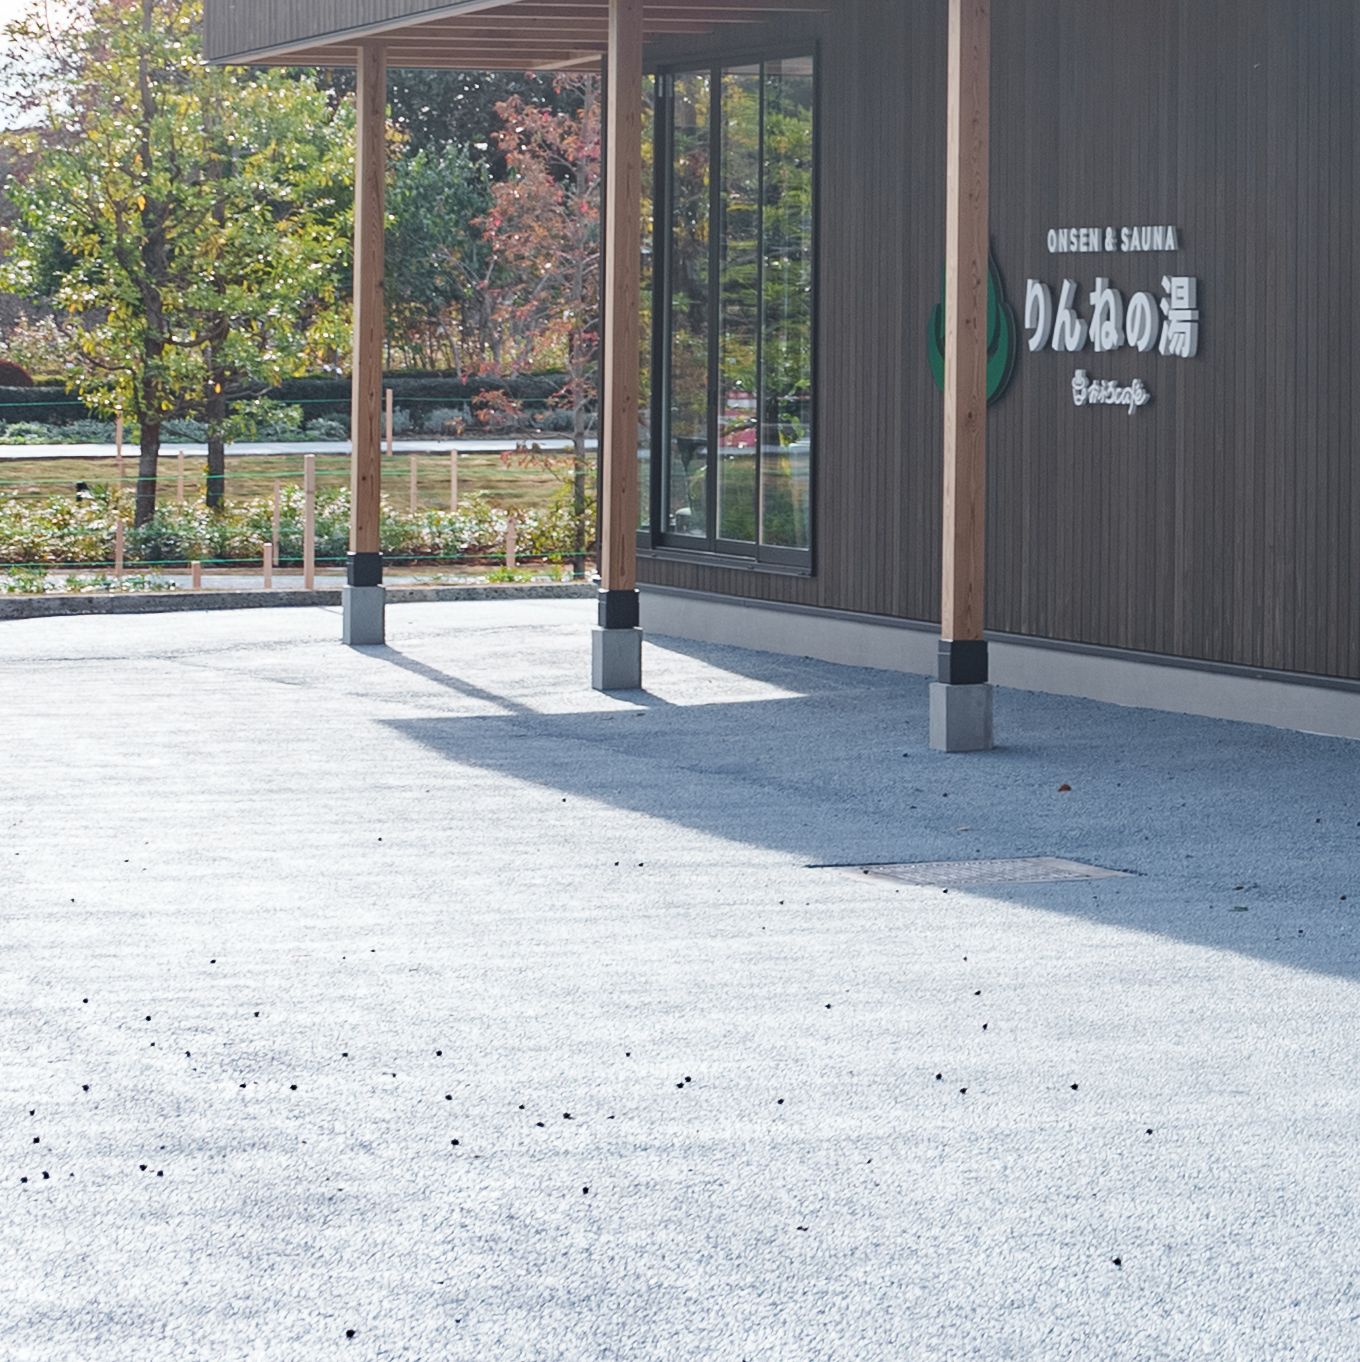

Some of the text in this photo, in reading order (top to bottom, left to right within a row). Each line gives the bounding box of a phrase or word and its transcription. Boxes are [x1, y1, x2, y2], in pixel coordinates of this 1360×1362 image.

[1047, 225, 1179, 253] ONSEN & SAUNA
[1024, 275, 1199, 358] りんねの湯
